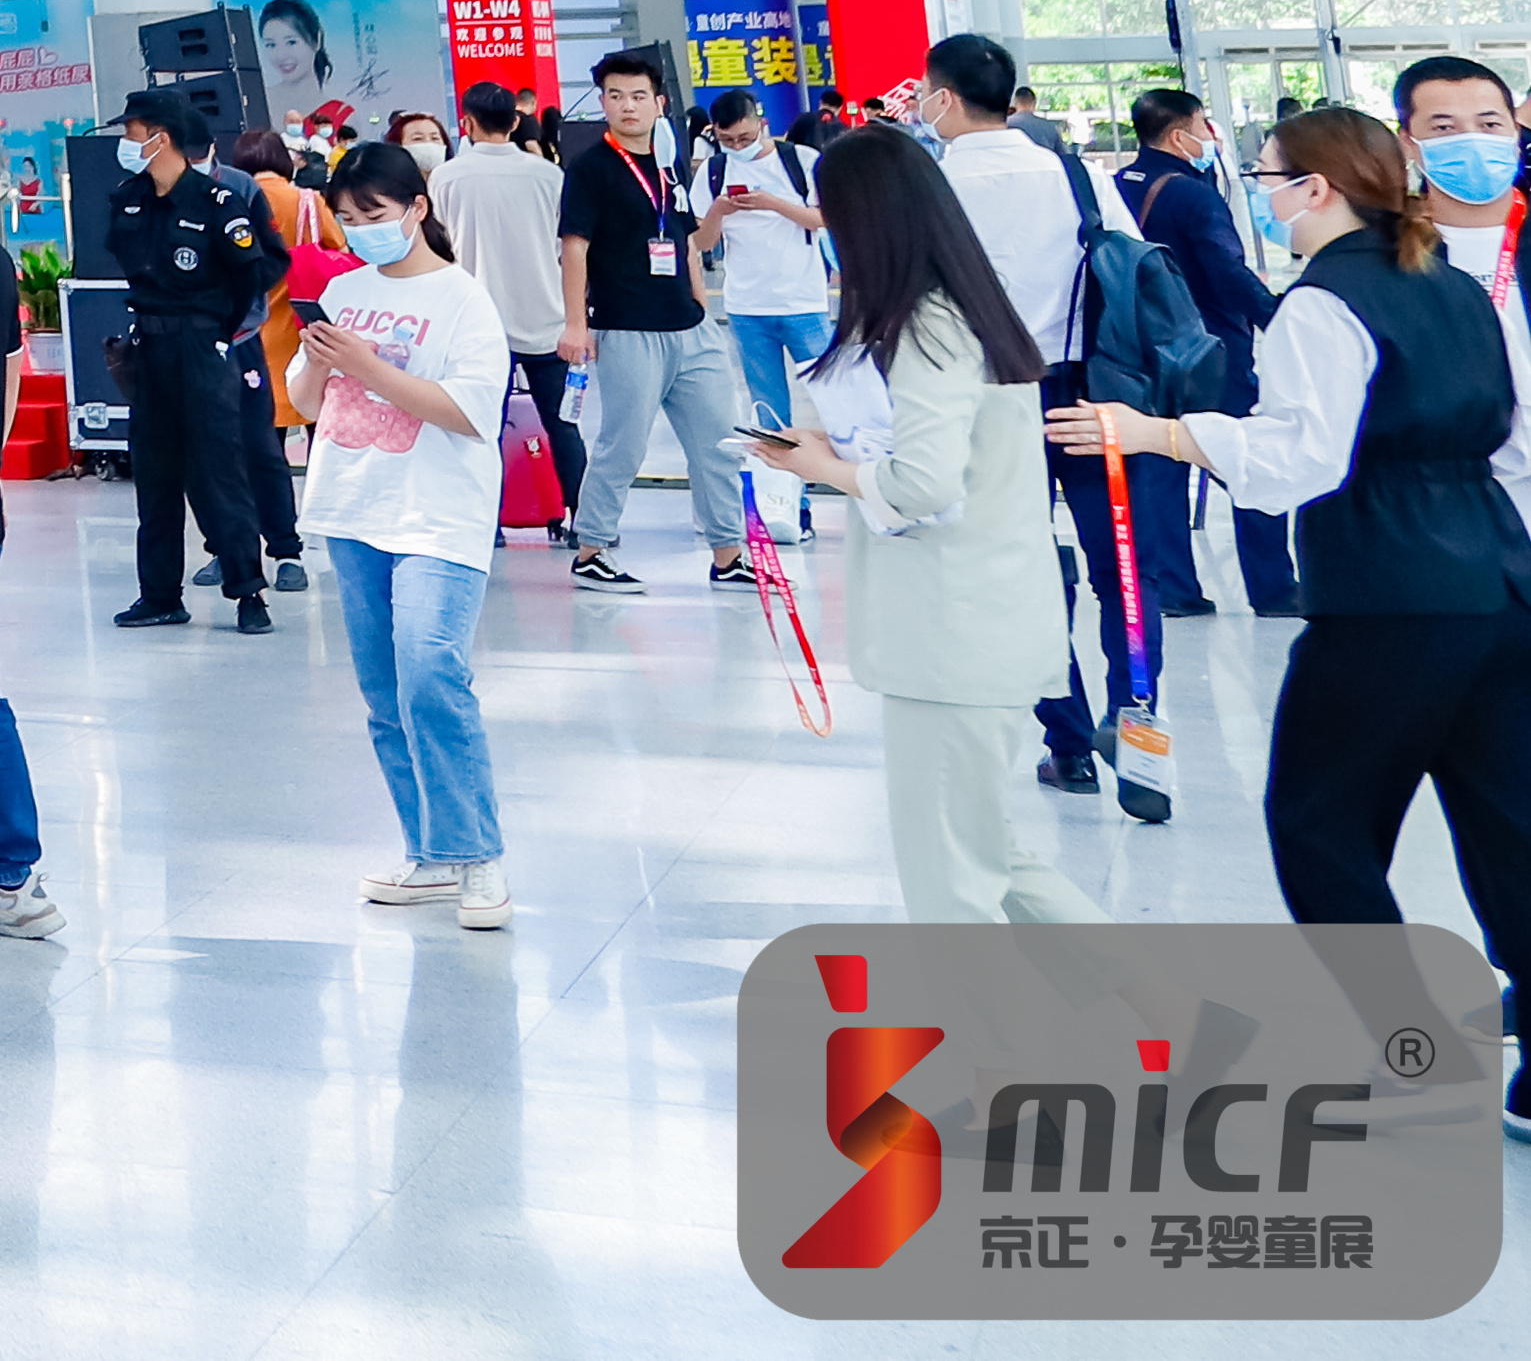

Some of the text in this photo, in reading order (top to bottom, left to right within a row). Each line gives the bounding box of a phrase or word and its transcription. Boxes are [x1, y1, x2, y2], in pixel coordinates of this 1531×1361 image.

[453, 0, 521, 20] W1-W4
[696, 11, 792, 32] 童创产业高地
[455, 25, 524, 42] 欢迎参观
[457, 42, 525, 58] WELCOME
[336, 306, 431, 347] GUCCI
